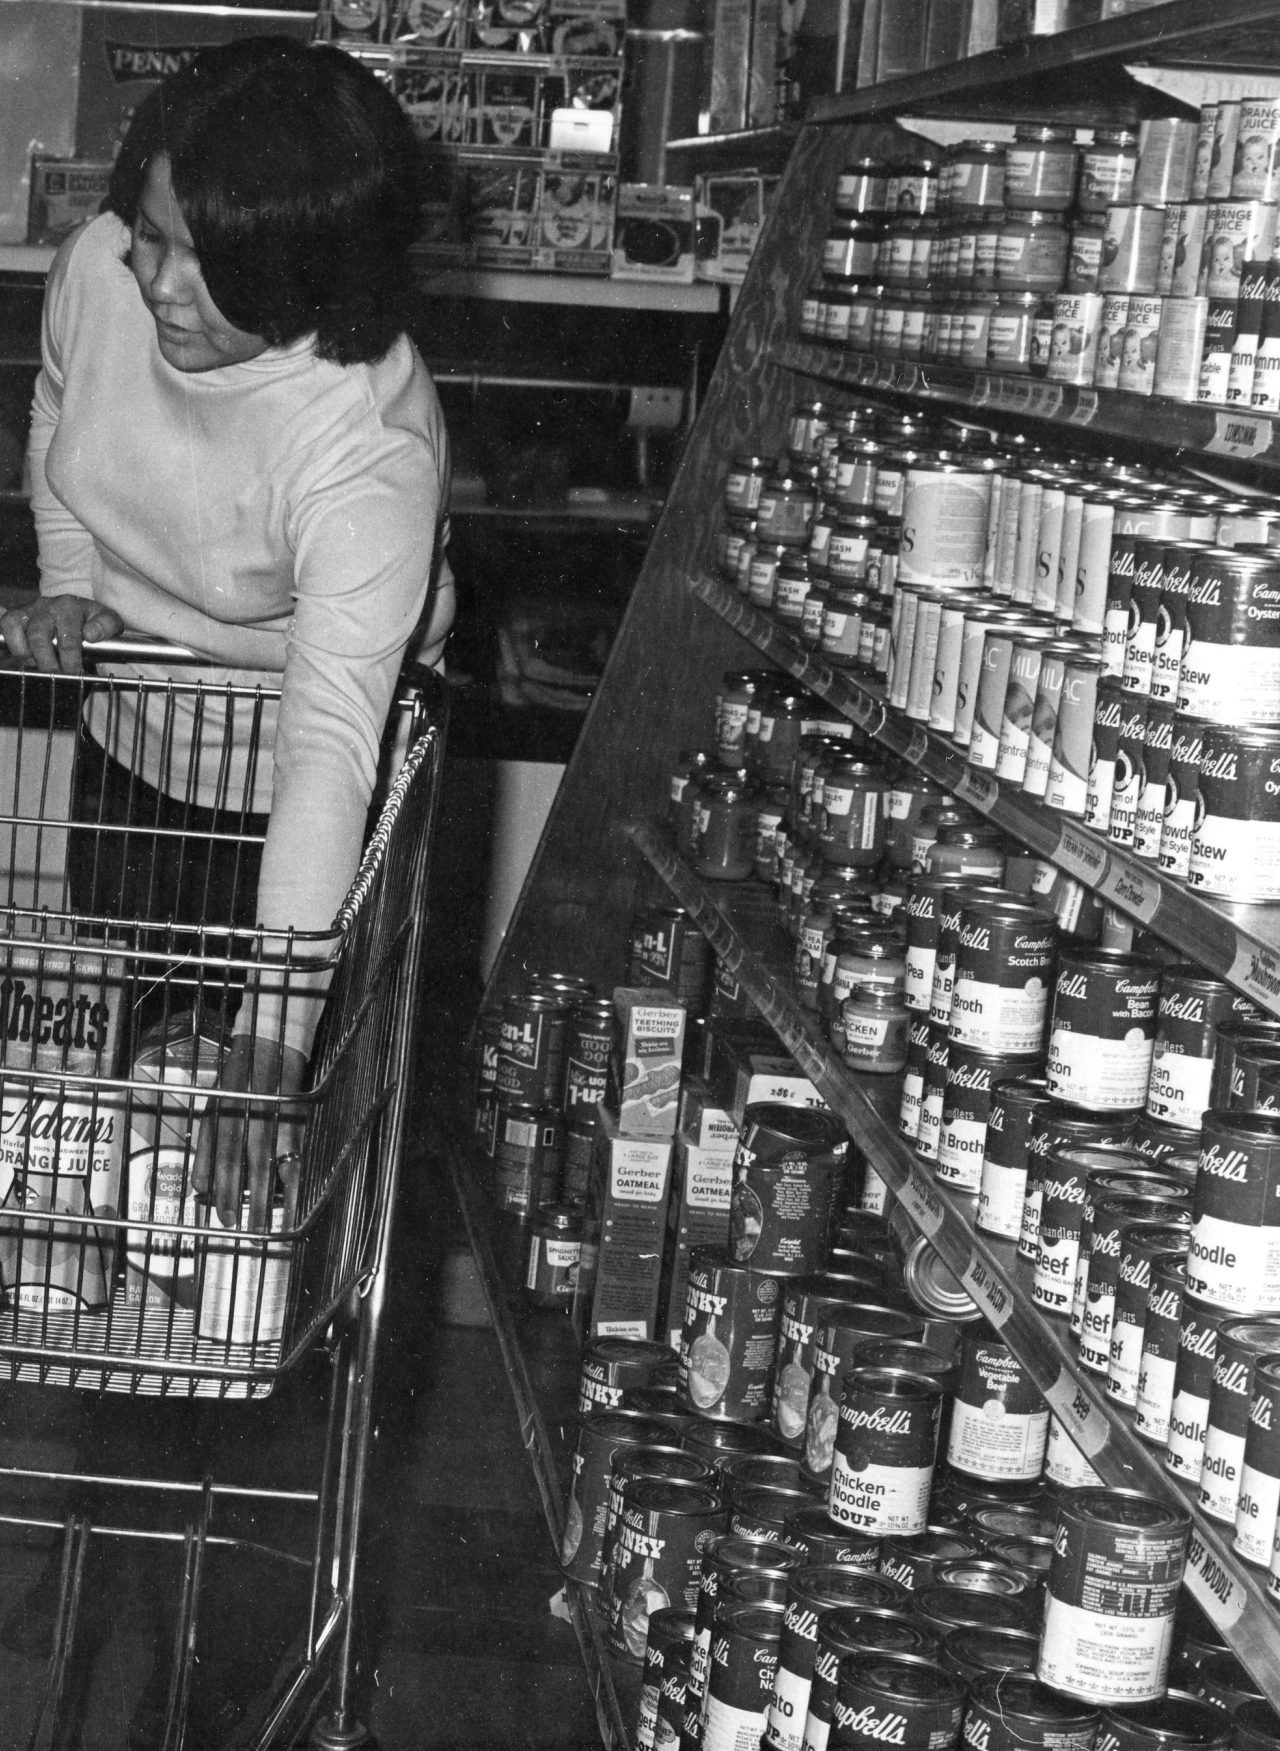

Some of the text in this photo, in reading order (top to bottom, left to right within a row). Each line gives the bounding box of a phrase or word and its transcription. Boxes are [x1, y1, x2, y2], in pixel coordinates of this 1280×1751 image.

[1243, 119, 1277, 130] JUICE
[1193, 840, 1227, 860] Stew
[1008, 956, 1038, 967] Scotch
[953, 993, 983, 1014] Broth
[1127, 1000, 1149, 1009] Bean
[638, 1009, 679, 1018] Gerber
[1112, 1010, 1129, 1018] with
[634, 1019, 679, 1027] TEETHING
[1, 1092, 114, 1145] Adams
[947, 1136, 984, 1154] Broth
[67, 1158, 111, 1172] JUCE
[618, 1167, 661, 1178] Gerber
[160, 1182, 181, 1192] Gold
[617, 1179, 660, 1190] OATMEAL
[1035, 1246, 1070, 1276] Beef
[979, 1368, 1019, 1383] Vegetable
[987, 1379, 1007, 1391] Beef
[834, 1467, 885, 1496] Chicken
[833, 1485, 881, 1511] Noodle
[832, 1504, 877, 1527] SOUP
[1200, 1553, 1233, 1604] NOODLE
